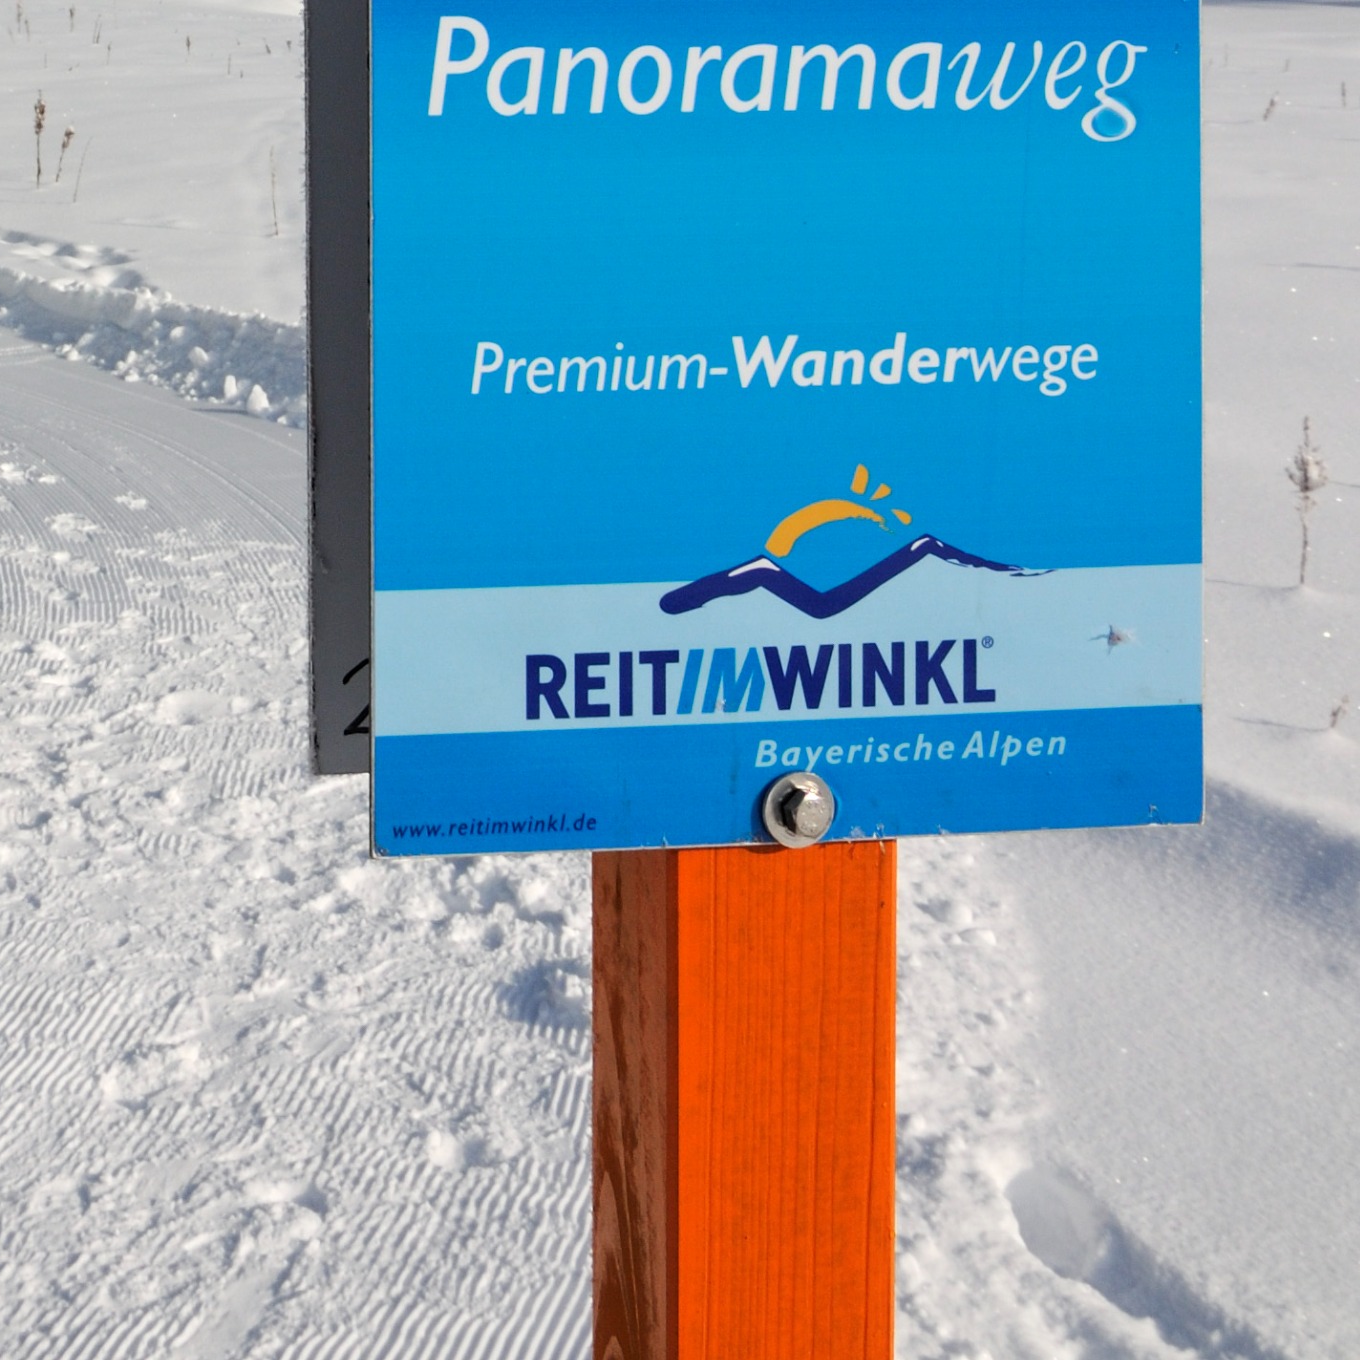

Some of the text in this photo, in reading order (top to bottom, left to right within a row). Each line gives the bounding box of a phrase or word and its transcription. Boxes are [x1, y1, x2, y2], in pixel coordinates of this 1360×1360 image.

[427, 15, 1148, 143] Panoramaweg
[470, 332, 1100, 398] Premium-Wanderwege
[754, 729, 1067, 772] Bayerische Alpen
[392, 812, 598, 839] www.reitimwinkl.de
